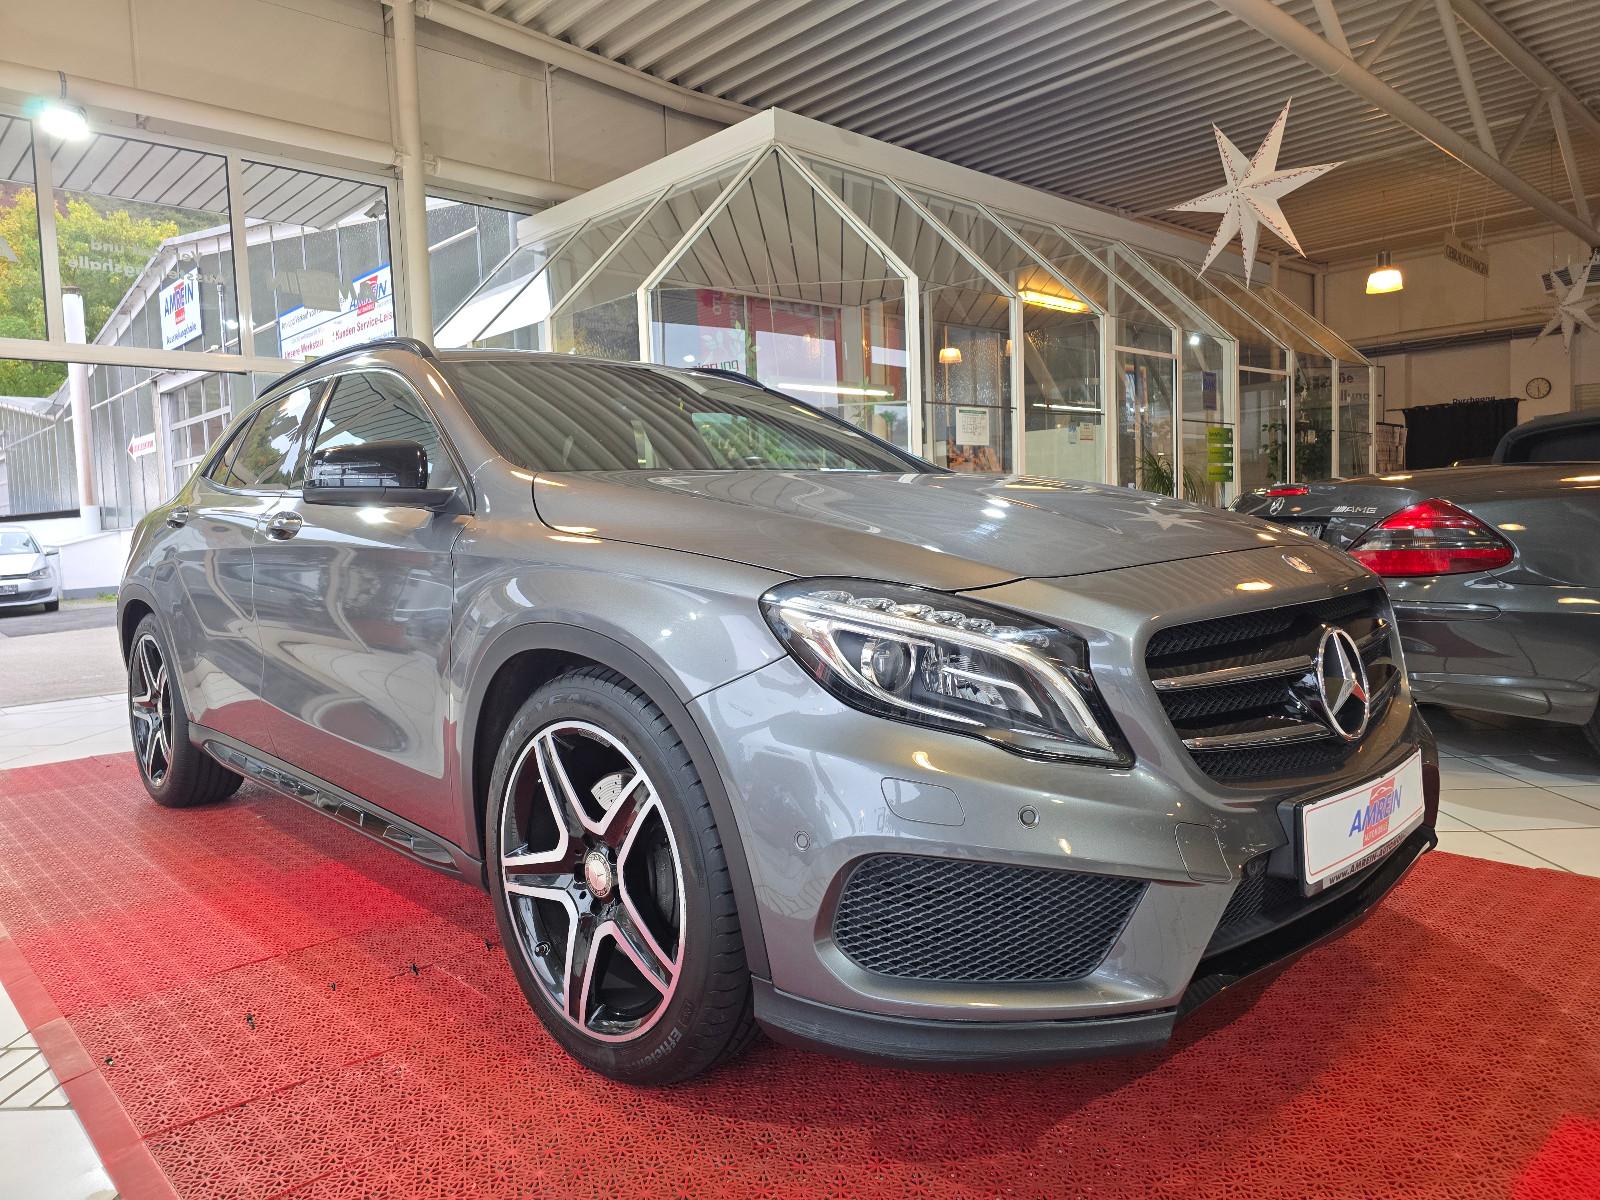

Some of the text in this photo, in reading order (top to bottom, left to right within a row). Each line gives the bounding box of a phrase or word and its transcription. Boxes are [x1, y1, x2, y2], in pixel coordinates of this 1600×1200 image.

[164, 282, 194, 318] AMREIN
[335, 326, 356, 341] Kunden
[1345, 506, 1378, 514] AMG
[1348, 784, 1403, 838] AMREIN
